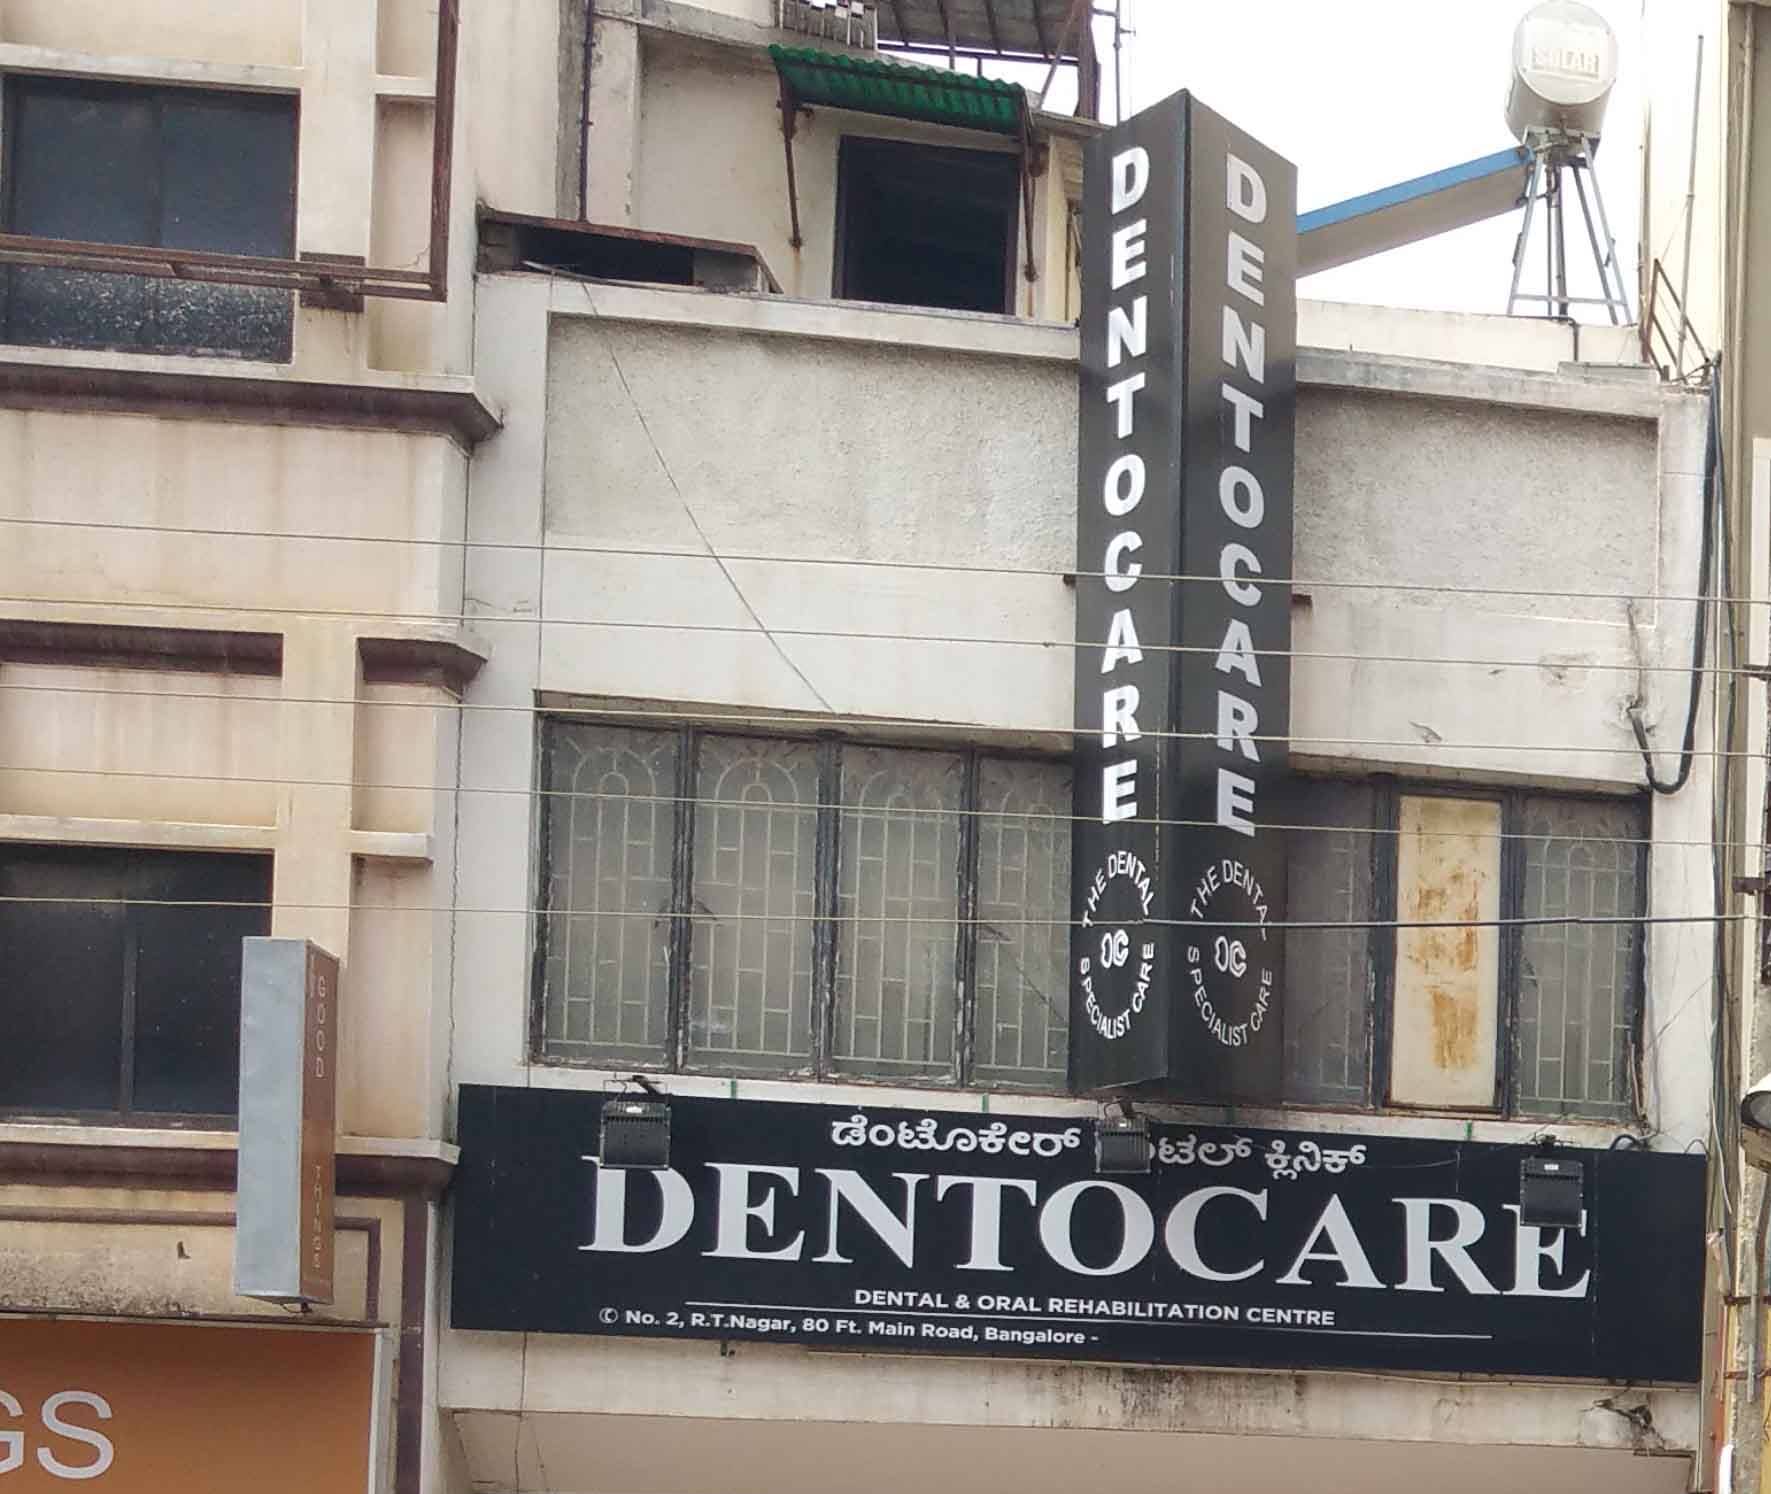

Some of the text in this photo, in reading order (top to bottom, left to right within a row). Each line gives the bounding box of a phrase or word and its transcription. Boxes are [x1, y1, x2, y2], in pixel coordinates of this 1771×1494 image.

[1102, 144, 1150, 826] DENTOCARE
[1214, 152, 1268, 839] DENTOCARE
[578, 1153, 1593, 1300] DENTOCARE
[625, 1308, 1085, 1346] No. 2, R.T.Nagar, 80 Ft. Main Road, Bangalore
[855, 1289, 1336, 1327] DENTAL & ORAL REHABILITATION CENTRE
